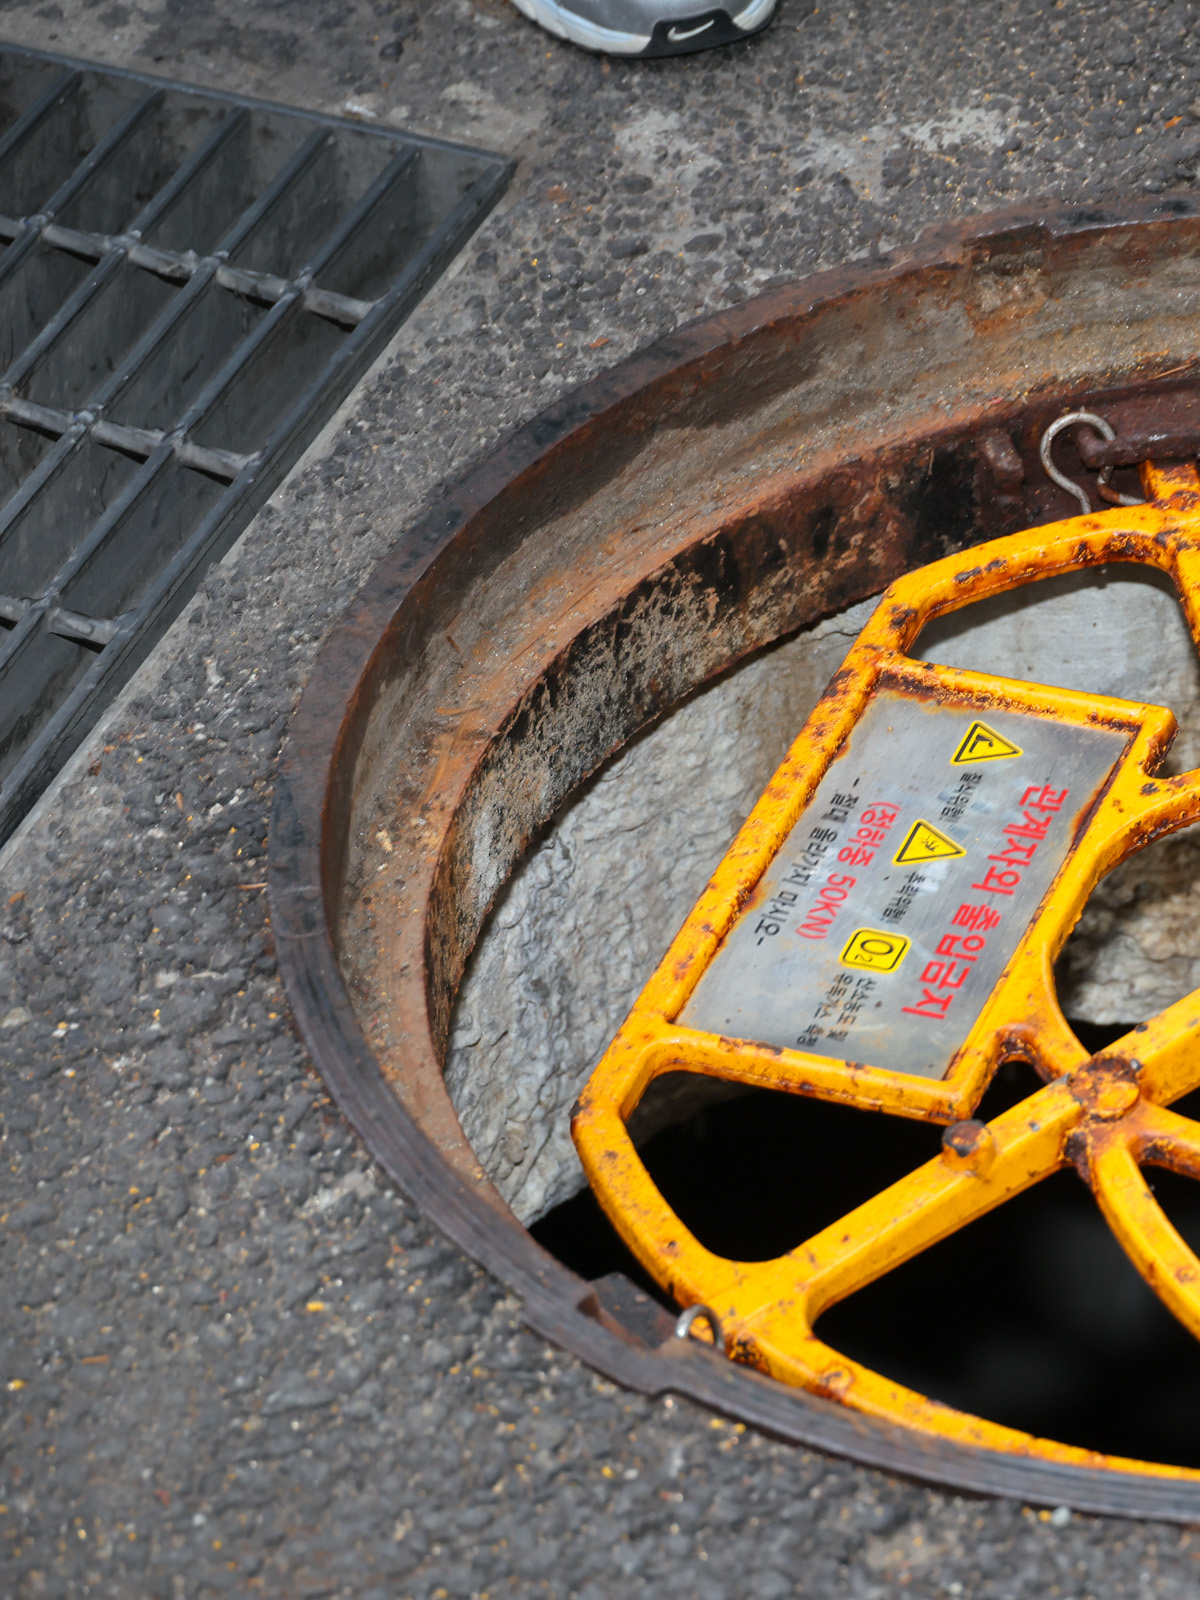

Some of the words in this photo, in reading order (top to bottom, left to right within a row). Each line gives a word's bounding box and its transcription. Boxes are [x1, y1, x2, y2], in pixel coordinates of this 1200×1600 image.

[821, 793, 859, 823] 절대
[838, 802, 901, 866] (정하중
[971, 784, 1069, 895] 관계자외
[783, 827, 838, 886] 올라가지
[797, 874, 856, 939] 50KN)
[902, 904, 1001, 1019] 출입금지
[838, 978, 876, 1024] 산소농도
